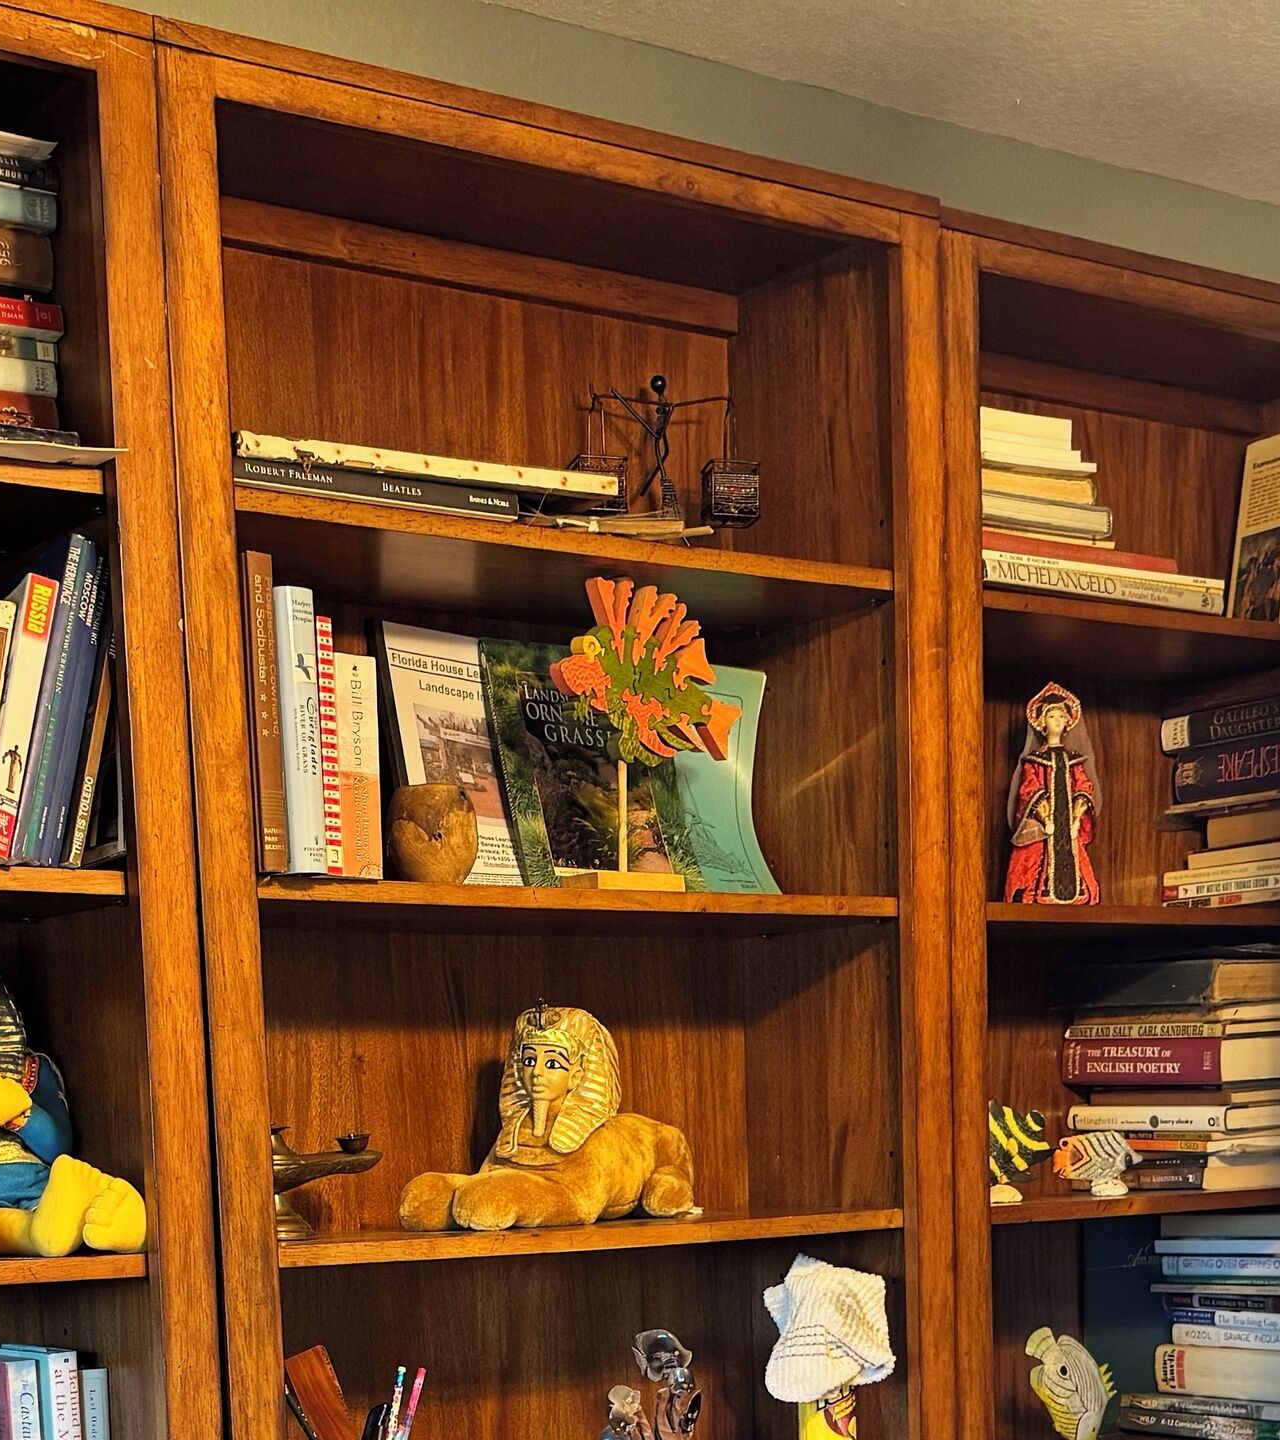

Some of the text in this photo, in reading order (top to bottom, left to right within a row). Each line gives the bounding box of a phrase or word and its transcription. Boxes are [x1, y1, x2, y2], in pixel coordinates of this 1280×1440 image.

[244, 462, 286, 477] ROBERT
[382, 482, 422, 496] BEATLES
[997, 562, 1117, 595] MICHELANGELO
[254, 575, 267, 686] and Sodbuster
[391, 652, 464, 677] Florida House
[419, 680, 474, 702] Landscape
[299, 705, 307, 731] RIVER
[351, 680, 364, 766] Bill Bryson
[1213, 703, 1279, 725] GALILEO'S
[306, 697, 319, 775] Everglades
[71, 776, 94, 857] THIS IS TOLEDO
[1094, 1026, 1110, 1037] AND
[1112, 1026, 1133, 1037] SALT
[1137, 1025, 1158, 1037] CARL
[1160, 1024, 1204, 1037] SANDBURG
[1102, 1046, 1161, 1057] TREASURY
[1161, 1050, 1172, 1058] OF
[1086, 1062, 1180, 1074] ENGLISH POETRY
[1179, 1142, 1199, 1150] USED
[1182, 1259, 1215, 1269] GETTING
[1216, 1259, 1238, 1269] OVER
[1239, 1259, 1271, 1269] GETTING
[1231, 1315, 1262, 1327] Teaching
[1185, 1331, 1211, 1340] KOZOL
[1224, 1332, 1251, 1342] SAVAGE
